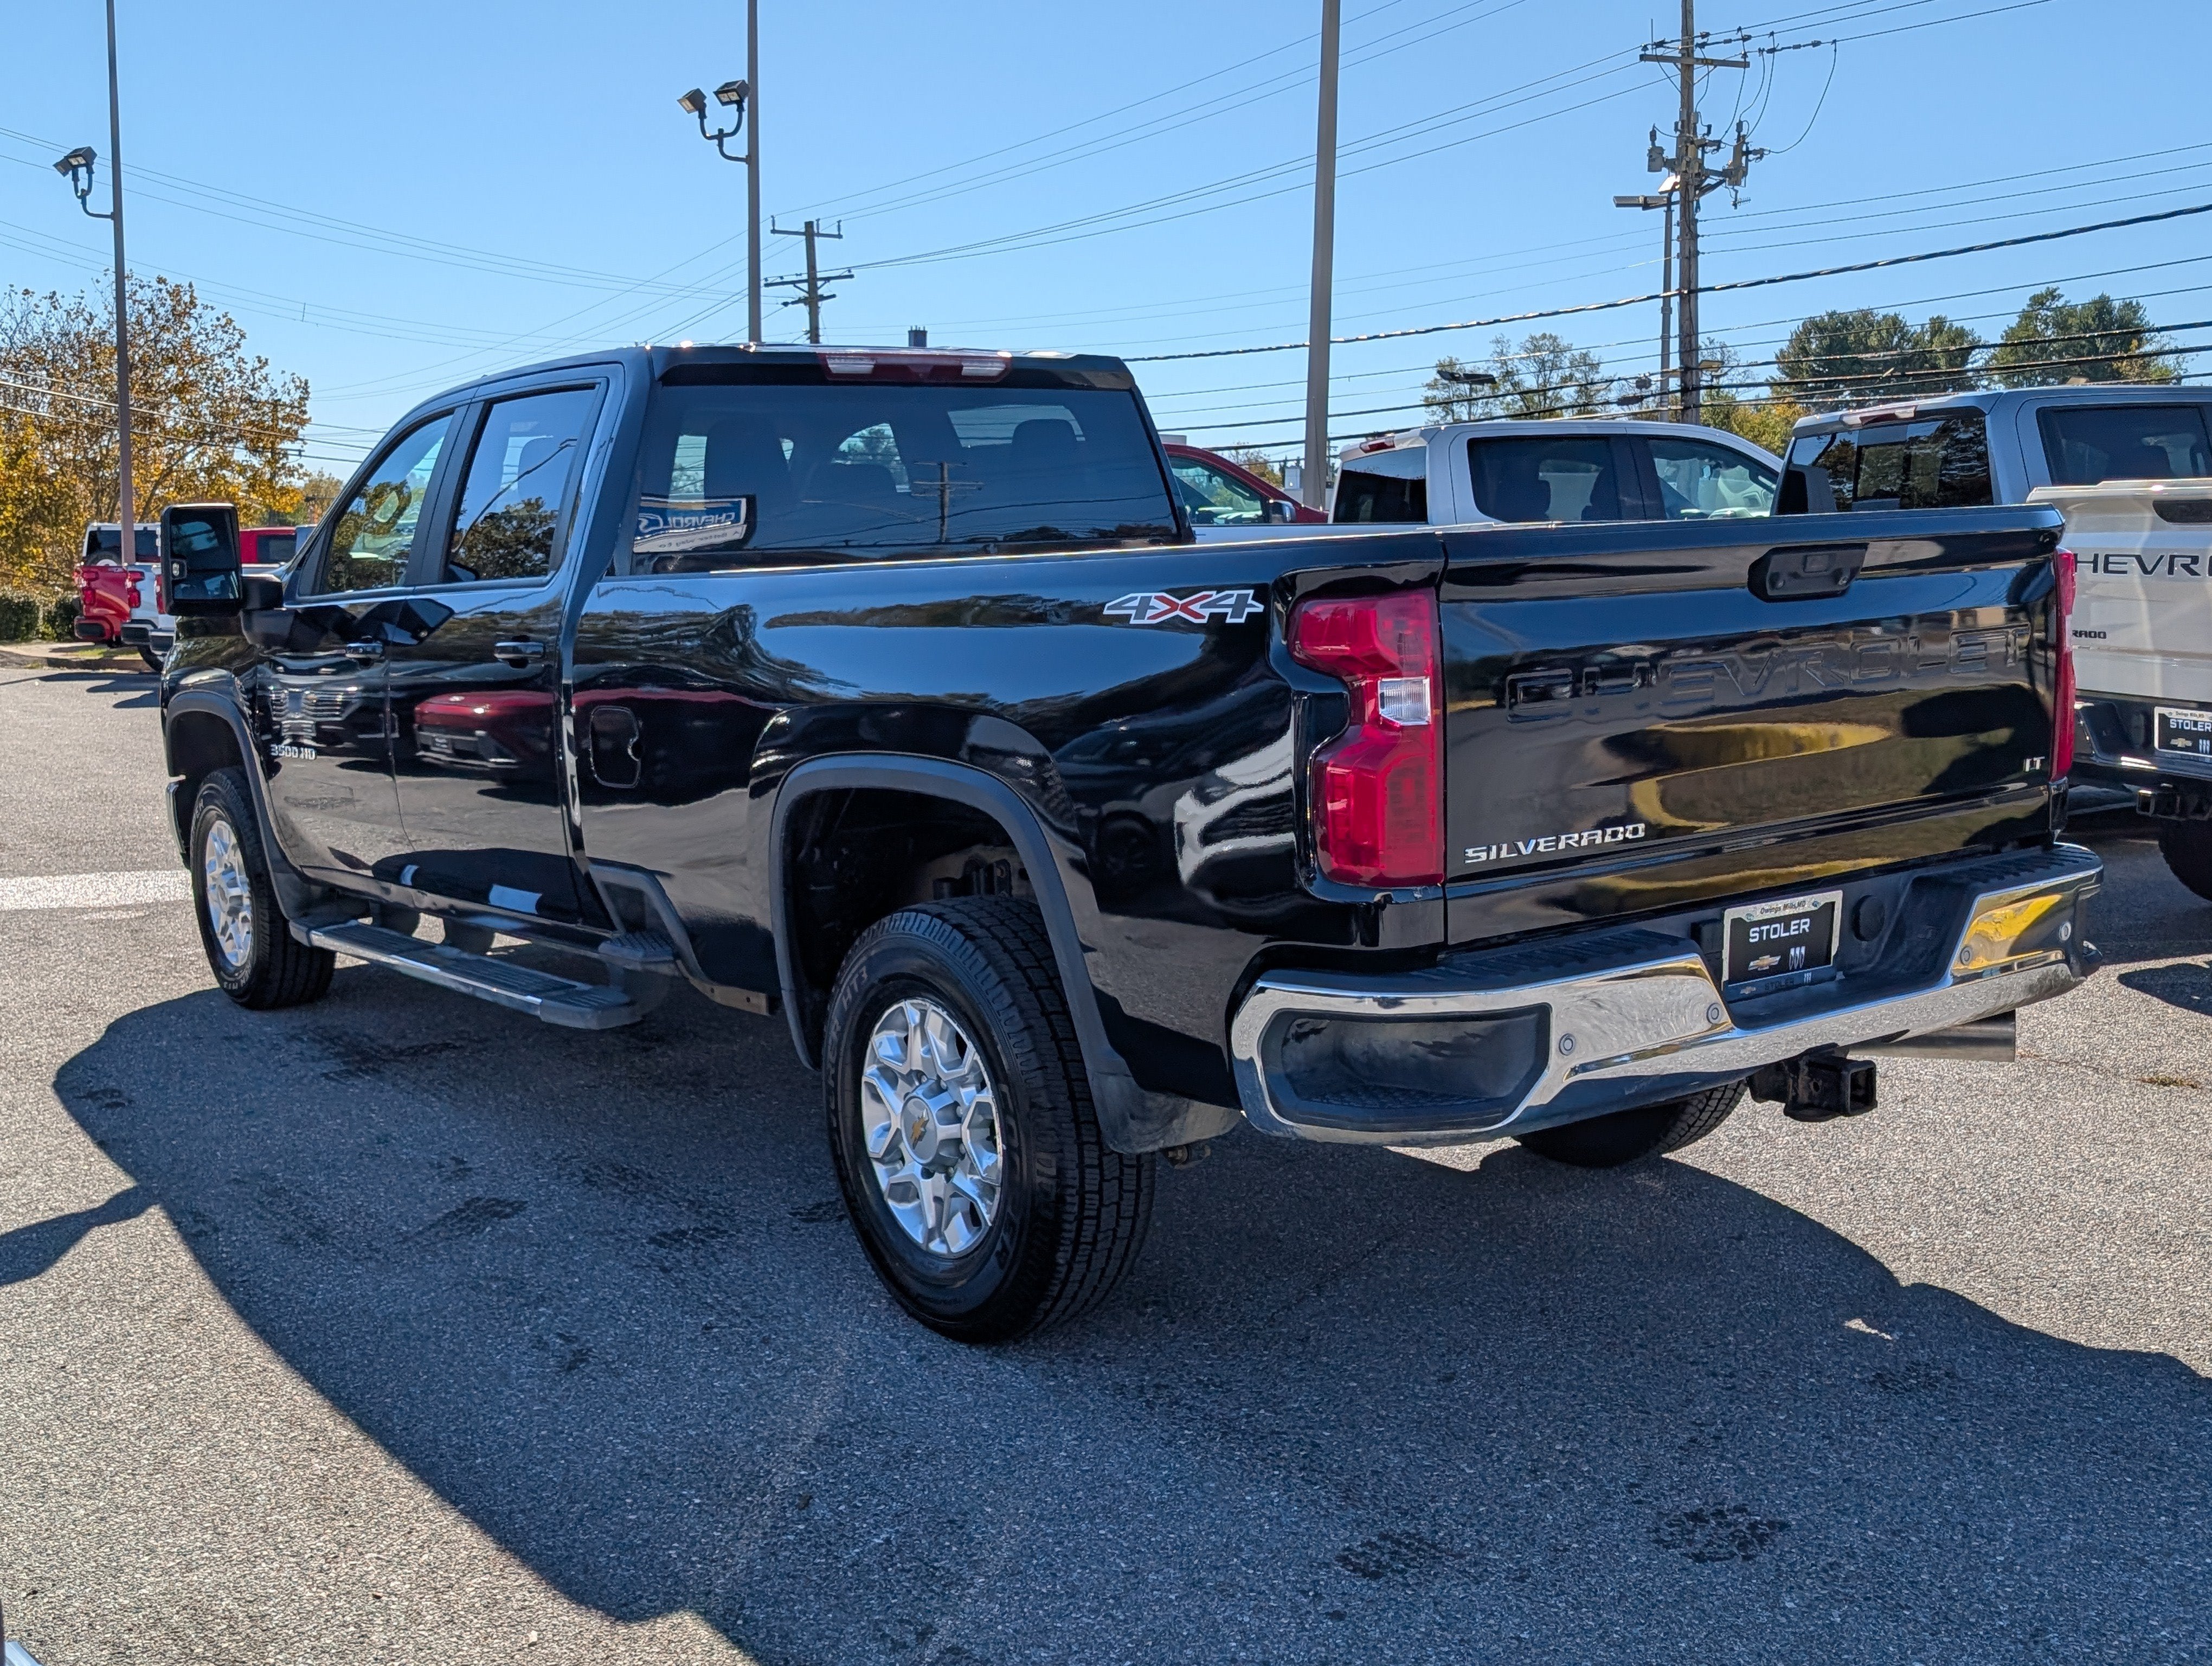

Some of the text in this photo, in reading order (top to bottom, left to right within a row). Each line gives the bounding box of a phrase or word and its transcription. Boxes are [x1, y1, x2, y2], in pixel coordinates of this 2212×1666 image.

[2074, 553, 2212, 576] HEVR
[2072, 630, 2107, 639] RADO
[1506, 621, 2031, 723] CHEVROLET
[2170, 719, 2212, 732] STOLER
[270, 744, 299, 758] 3500
[2023, 756, 2045, 772] LT
[1464, 823, 1645, 864] SILVERADO
[1748, 918, 1810, 943] STOLER
